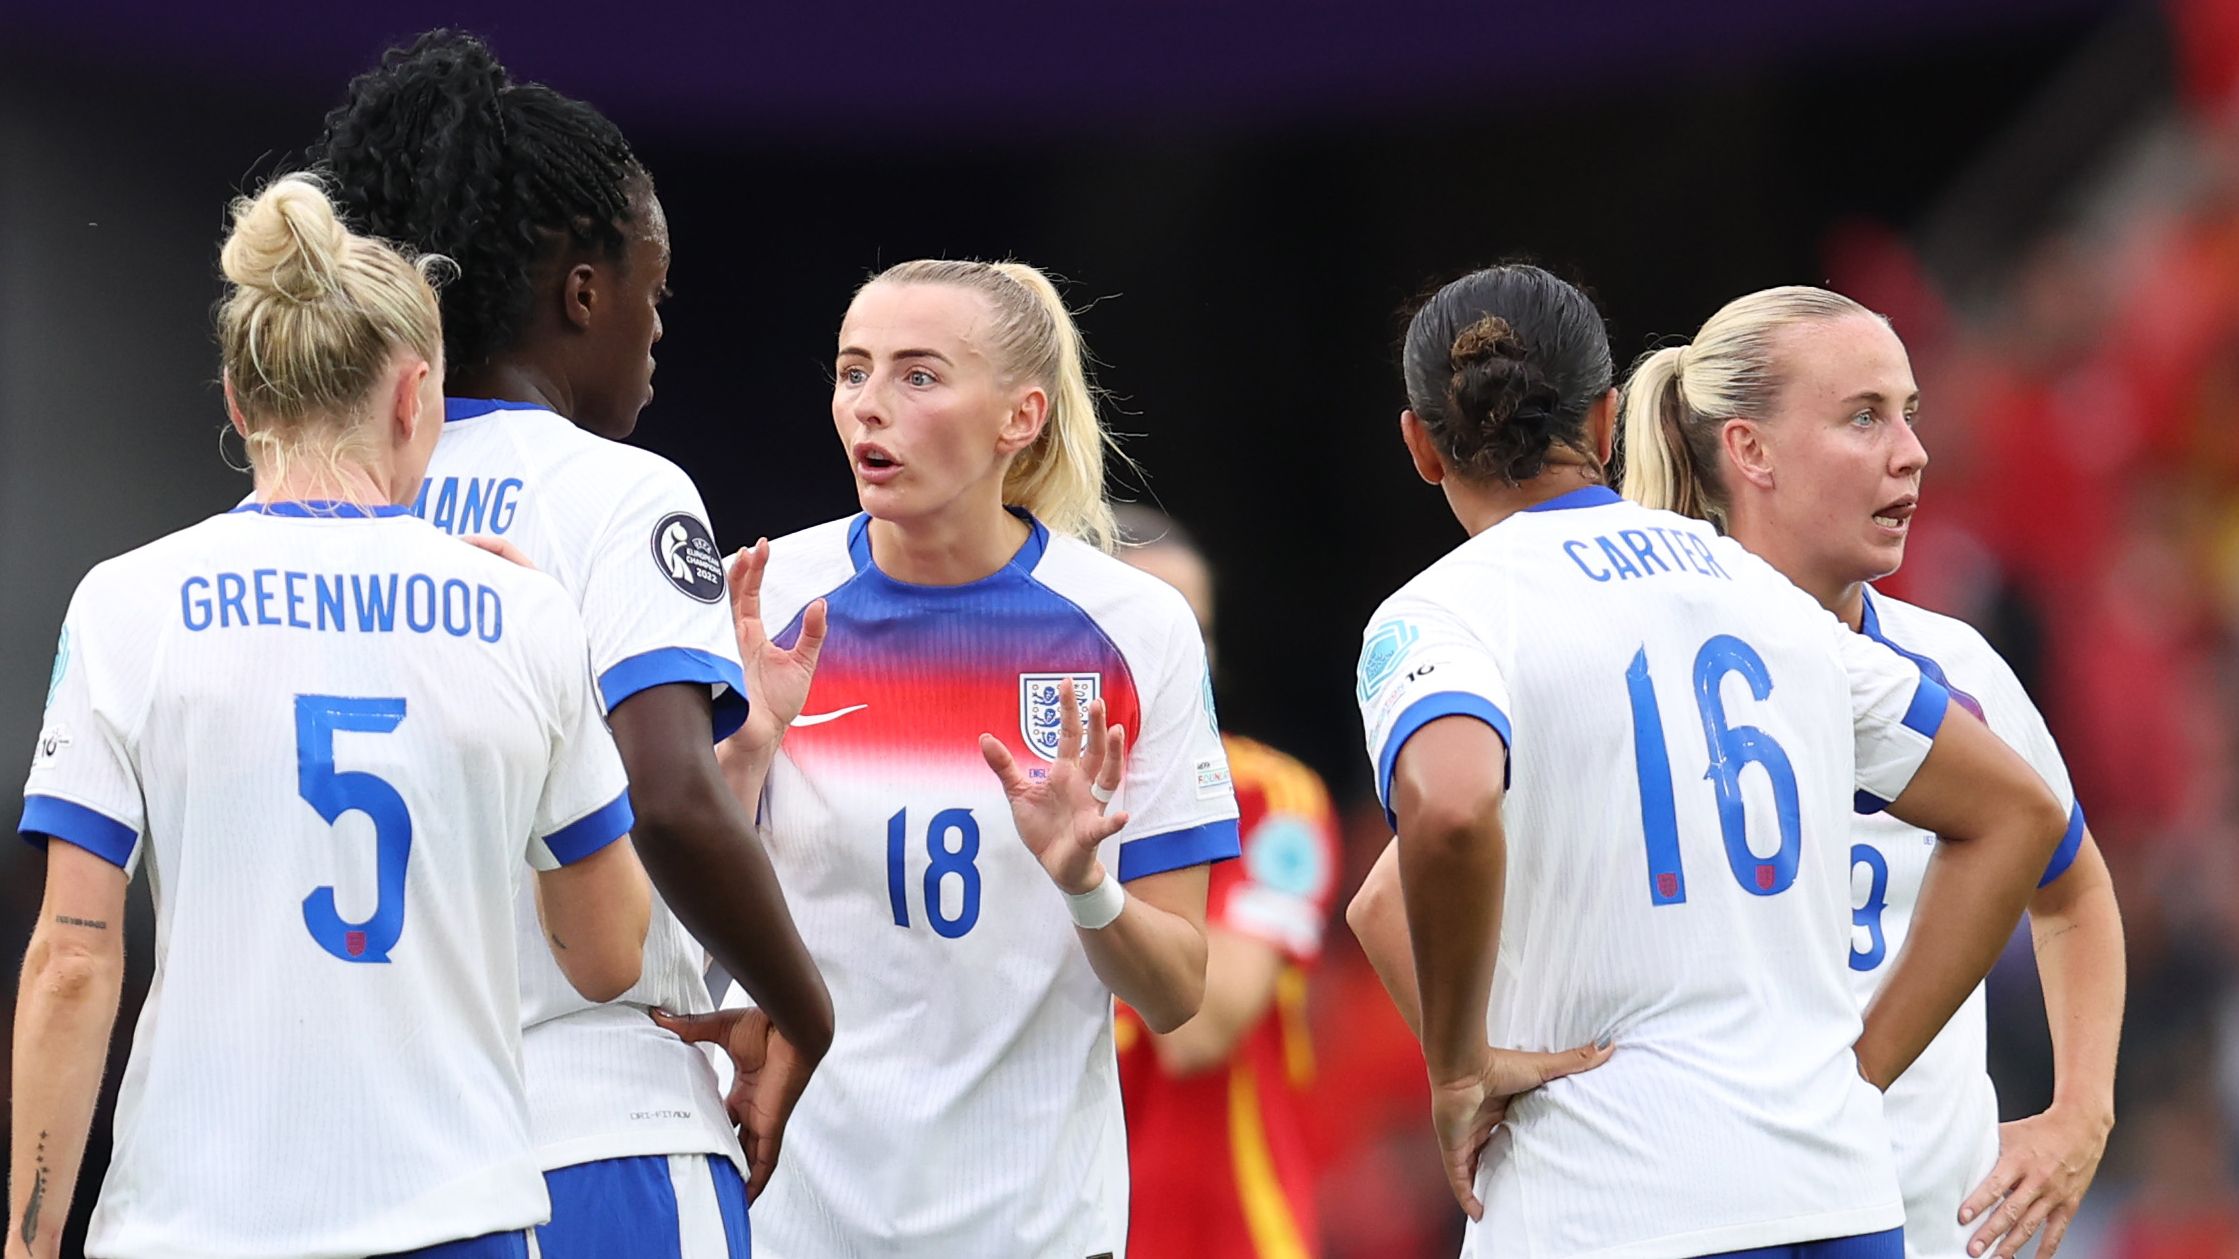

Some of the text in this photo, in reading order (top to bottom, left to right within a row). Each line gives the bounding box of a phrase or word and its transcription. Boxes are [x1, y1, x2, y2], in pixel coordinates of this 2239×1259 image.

[180, 568, 504, 644] GREENWOOD
[695, 567, 719, 585] 2022
[1562, 527, 1732, 582] CARTER
[1624, 633, 1803, 908] 16
[293, 693, 413, 965] 5
[886, 807, 982, 939] 18
